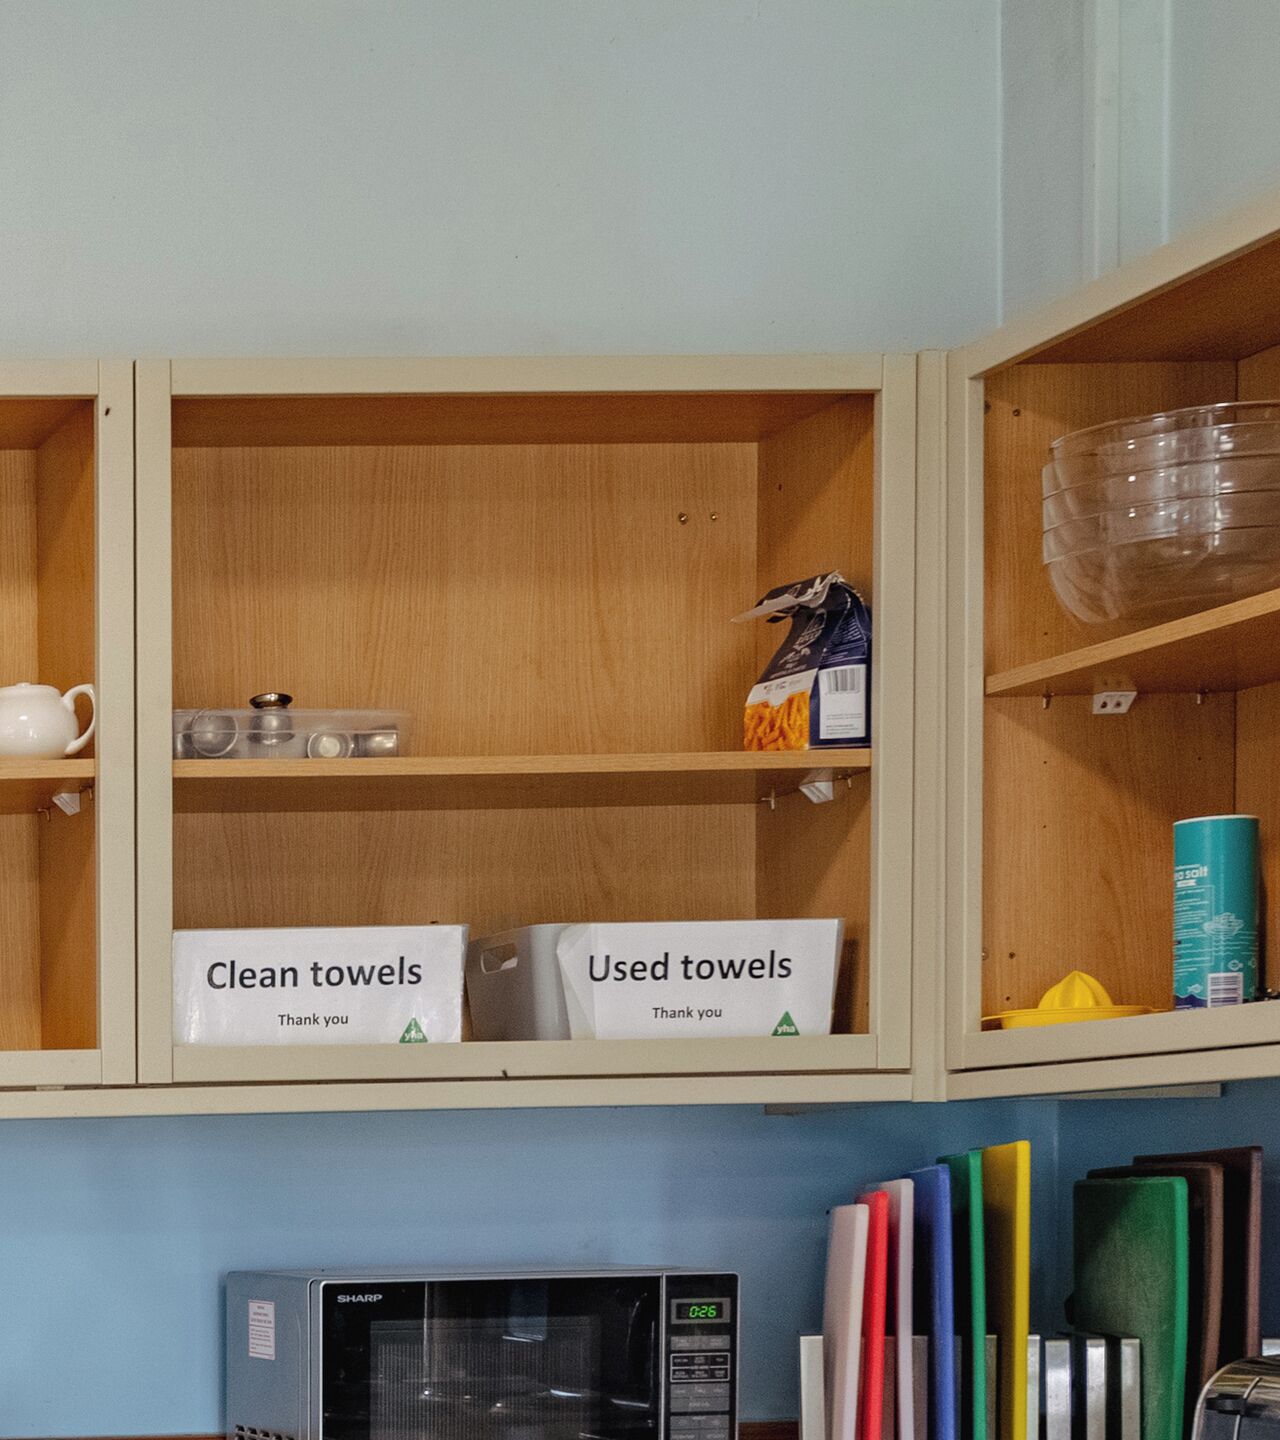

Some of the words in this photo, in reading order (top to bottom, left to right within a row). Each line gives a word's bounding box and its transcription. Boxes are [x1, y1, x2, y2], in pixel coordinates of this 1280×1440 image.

[1185, 865, 1208, 880] salt
[206, 960, 299, 990] Clean
[310, 956, 422, 987] towels
[588, 952, 670, 982] Used
[680, 949, 792, 980] towels
[278, 1013, 320, 1026] Thank
[323, 1014, 349, 1028] you
[652, 1006, 694, 1019] Thank
[697, 1008, 723, 1021] you
[776, 1024, 796, 1035] yha
[337, 1294, 383, 1303] SHARP
[689, 1305, 717, 1318] 0:26
